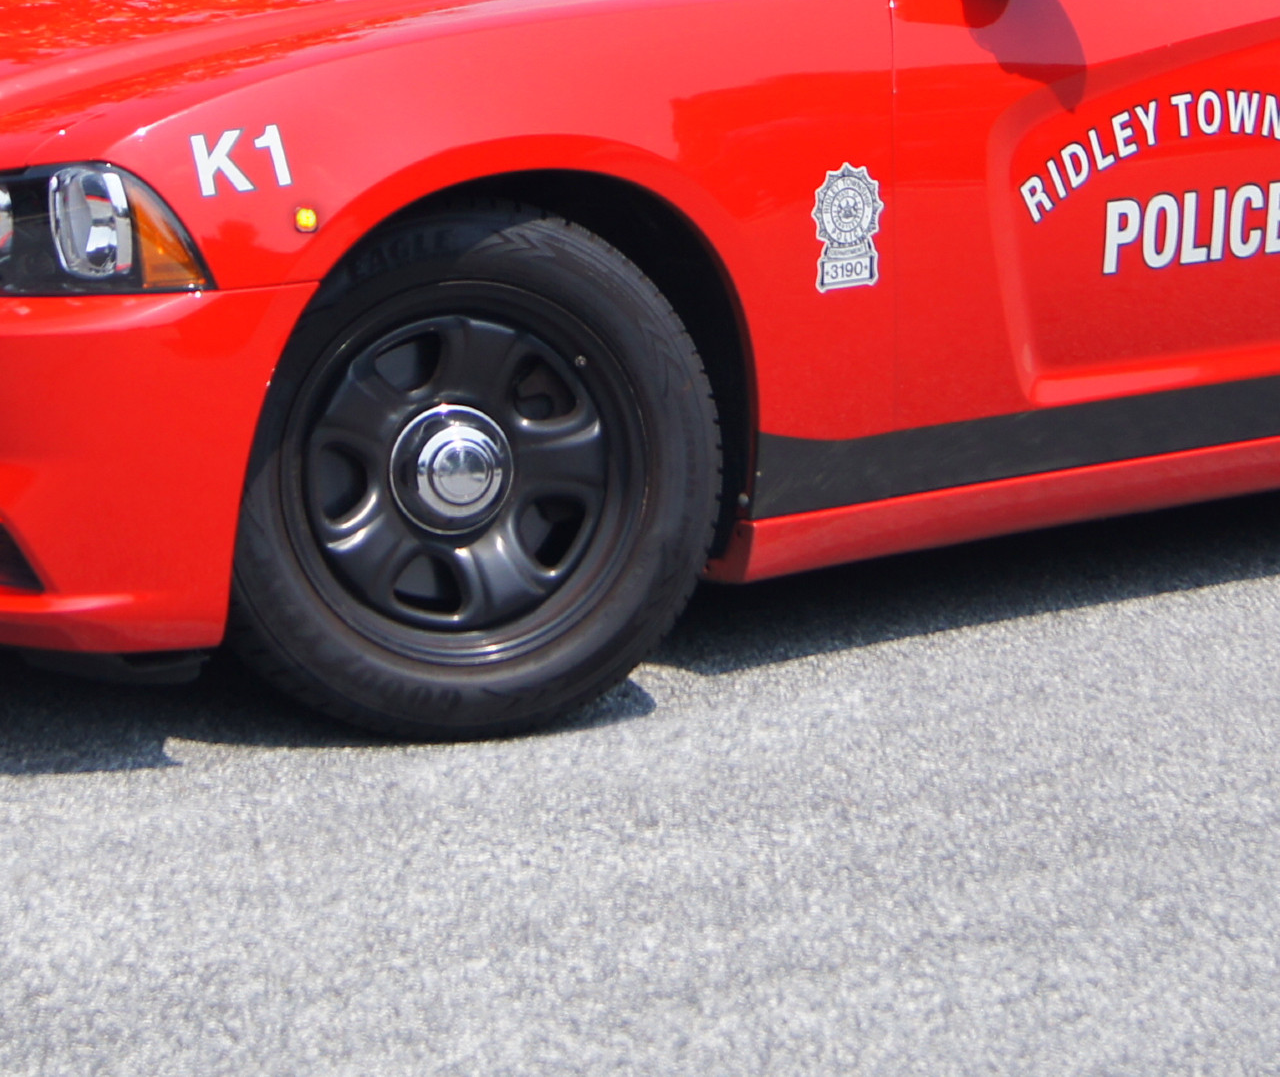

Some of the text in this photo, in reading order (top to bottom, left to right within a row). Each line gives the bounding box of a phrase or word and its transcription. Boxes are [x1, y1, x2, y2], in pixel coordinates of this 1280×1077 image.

[190, 124, 293, 197] K1
[1019, 100, 1158, 223] RIDLEY
[830, 261, 863, 279] 3190
